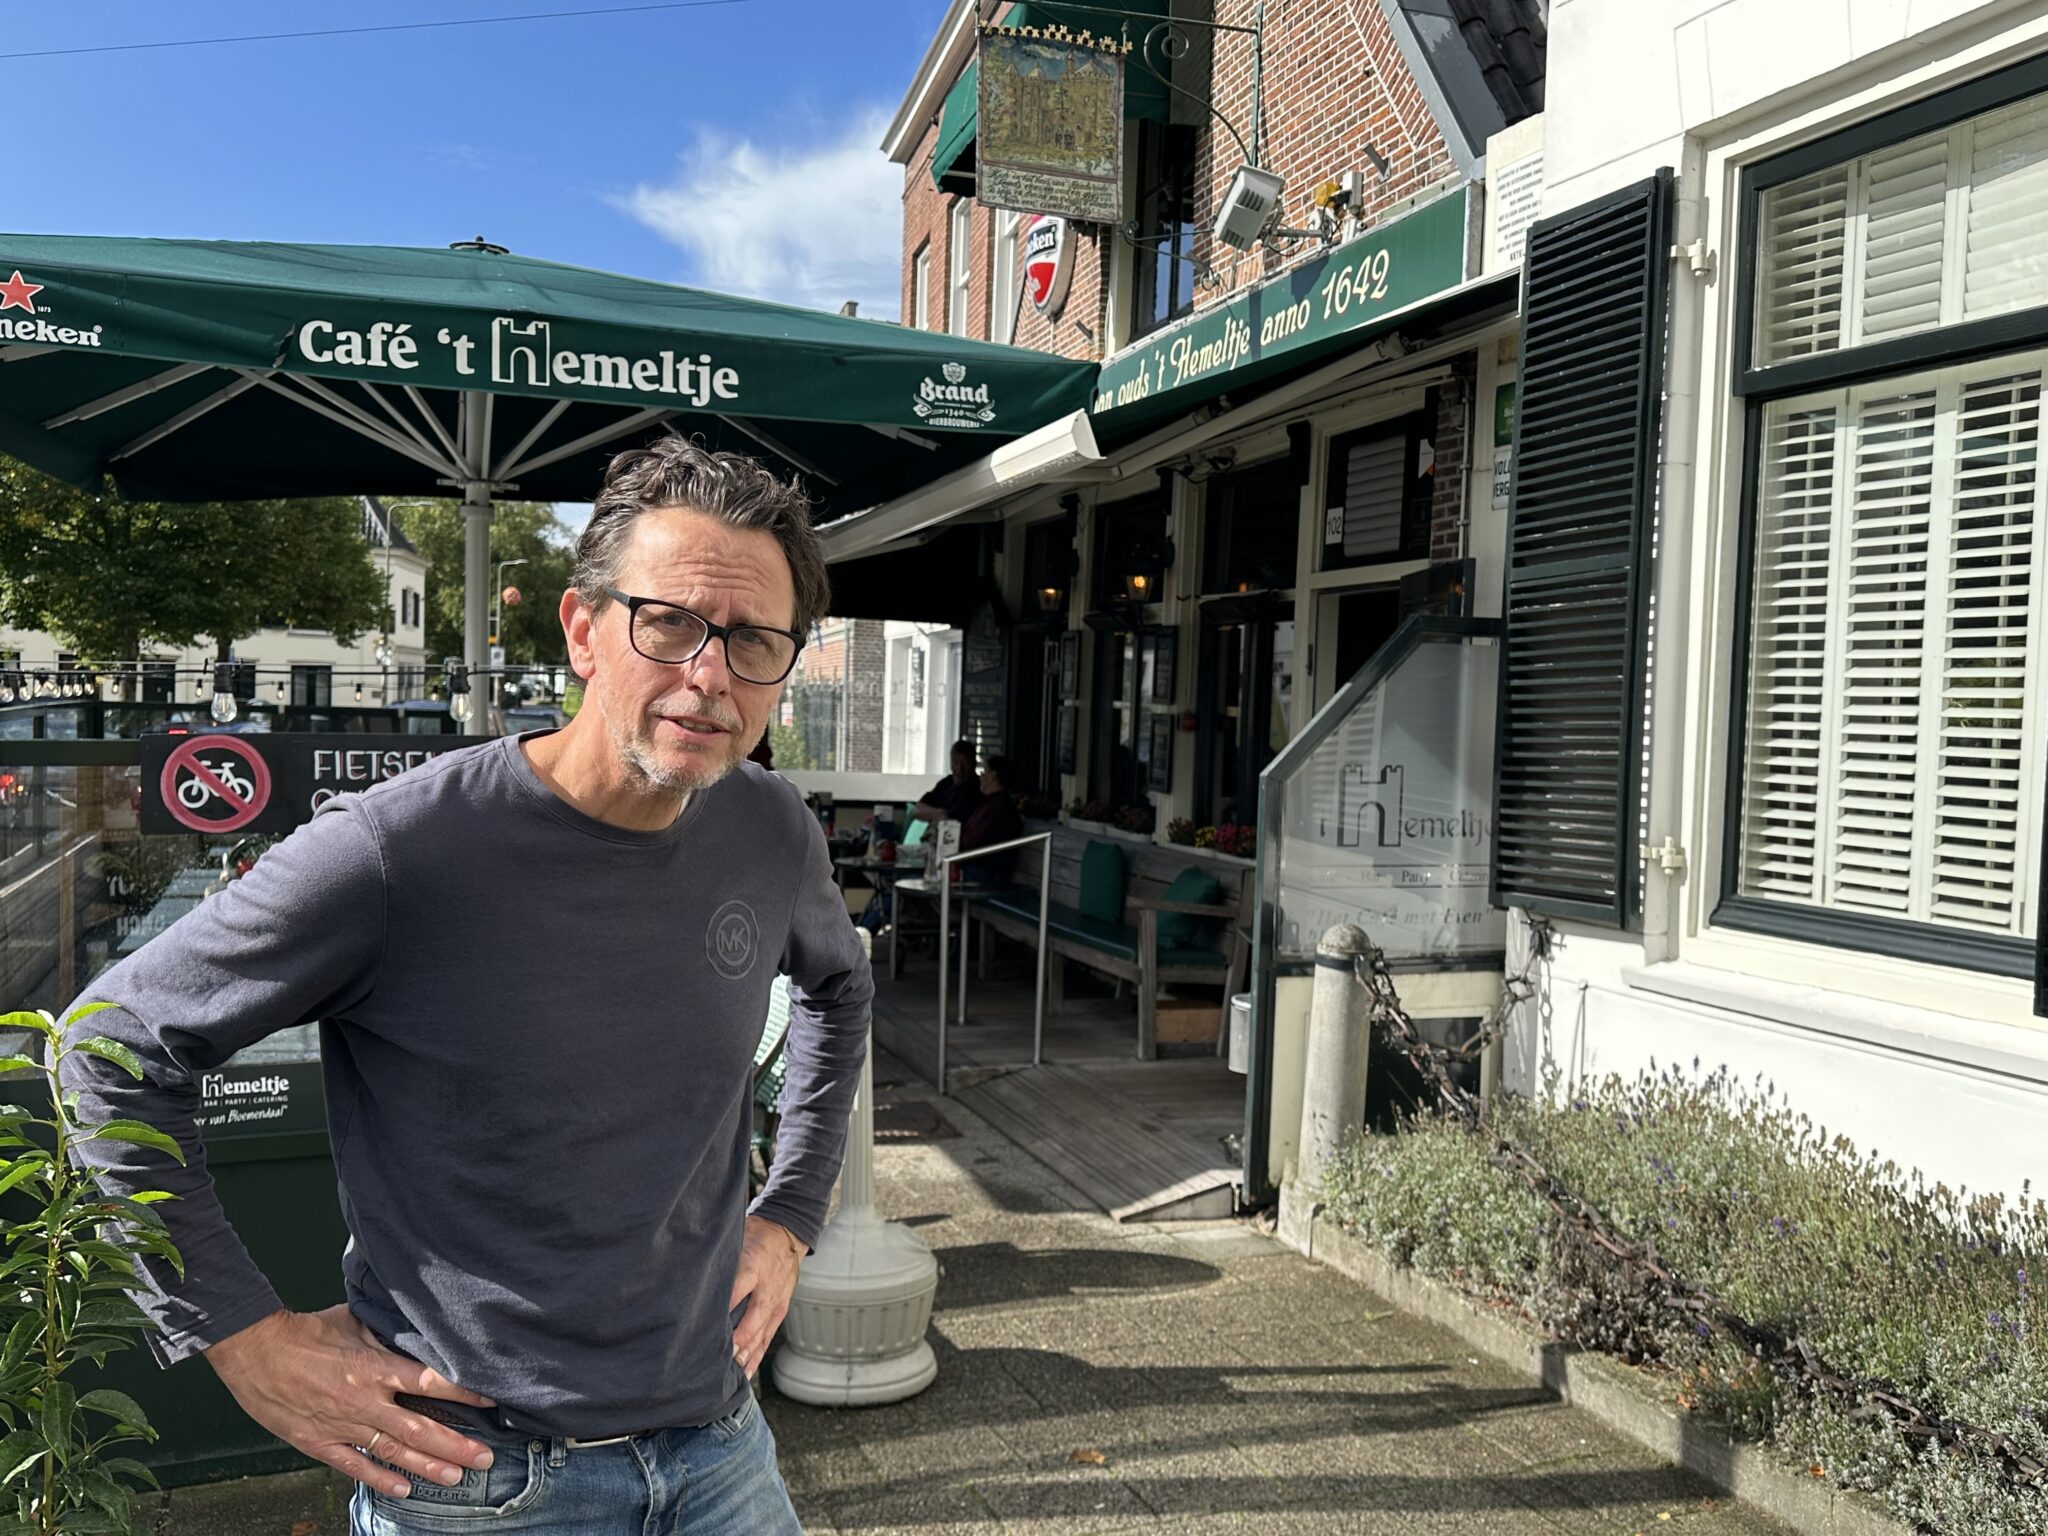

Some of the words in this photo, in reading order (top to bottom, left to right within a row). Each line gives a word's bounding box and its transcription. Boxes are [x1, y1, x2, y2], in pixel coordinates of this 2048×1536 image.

[1118, 358, 1150, 405] ouds
[1170, 316, 1251, 388] Hemeltje
[1260, 299, 1311, 346] anno
[1321, 248, 1391, 320] 1642
[299, 320, 419, 369] Café
[491, 317, 741, 407] Hemeltje
[920, 376, 990, 404] Brand
[1327, 515, 1342, 536] 102
[719, 927, 747, 953] MK
[202, 1073, 290, 1098] Hemeltje
[224, 1097, 247, 1105] PARTY
[253, 1094, 289, 1104] CATERING
